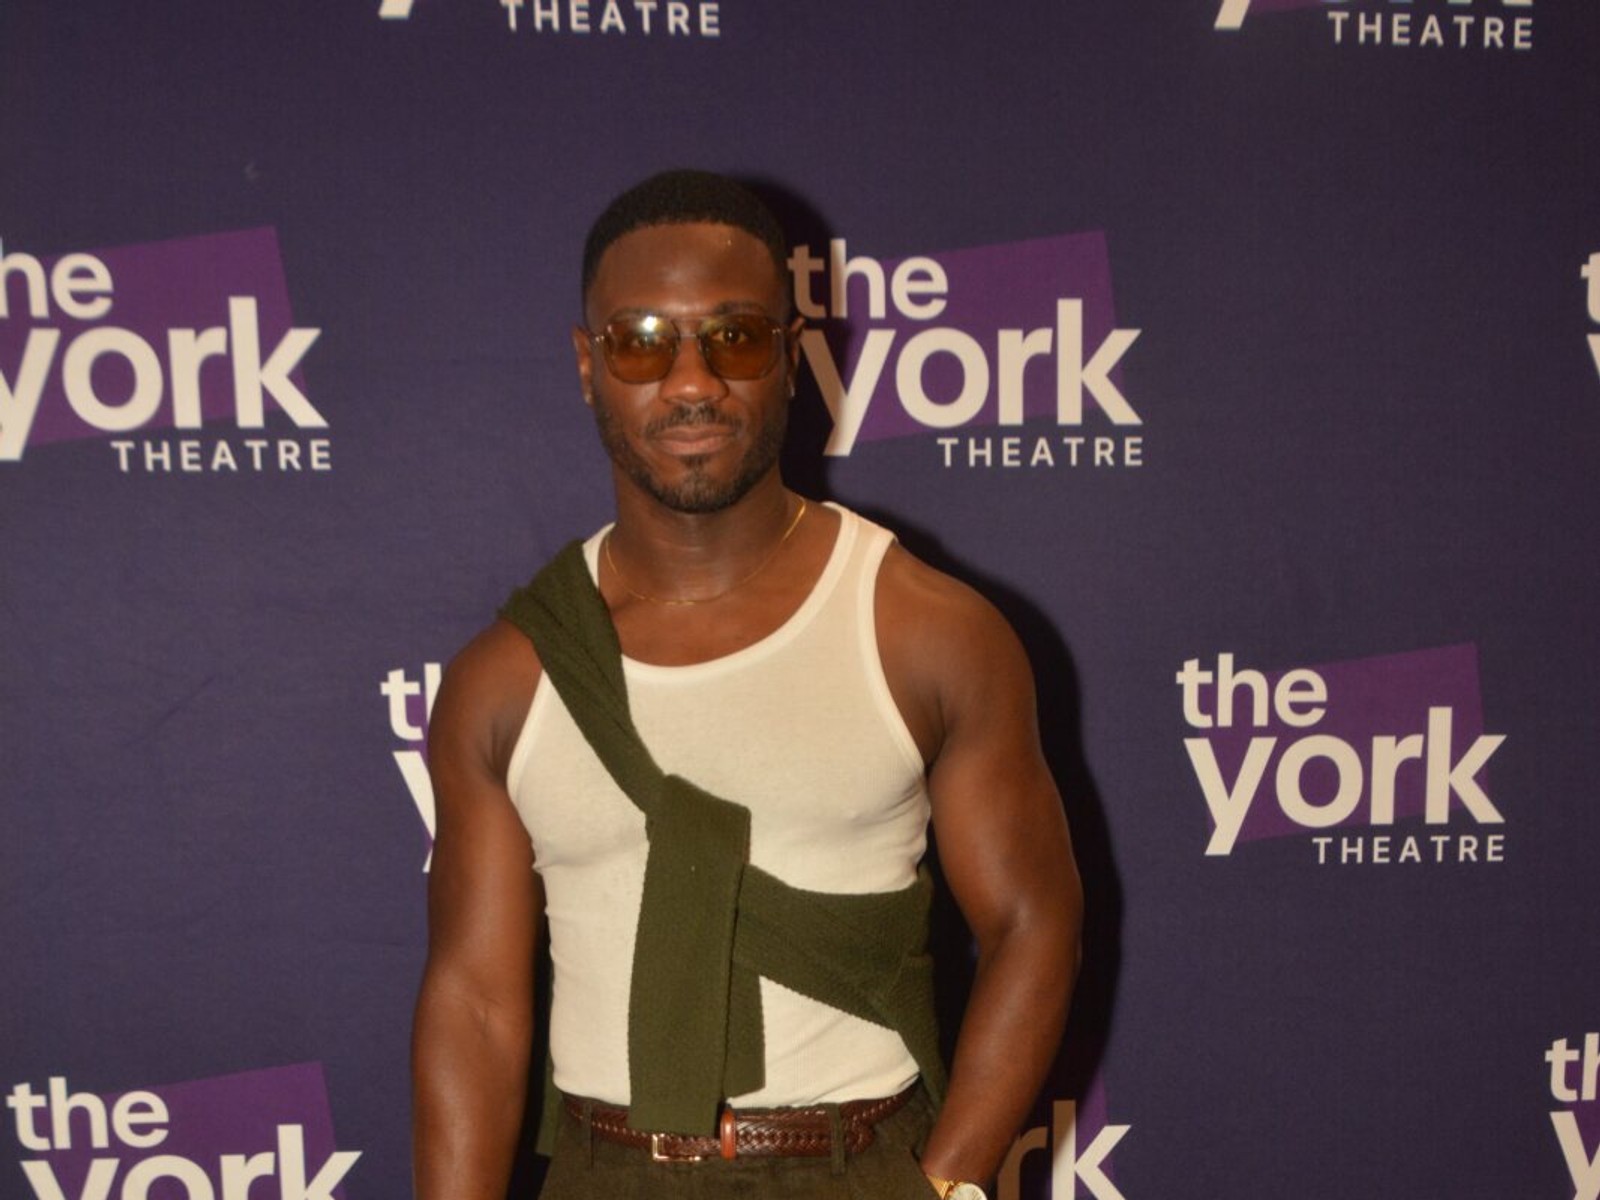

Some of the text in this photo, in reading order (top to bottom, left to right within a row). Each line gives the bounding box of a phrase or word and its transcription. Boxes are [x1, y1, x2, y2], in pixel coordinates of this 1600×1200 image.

[503, 0, 721, 36] THEATRE
[1328, 11, 1533, 49] THEATRE
[0, 237, 114, 320] he
[787, 238, 948, 320] the
[800, 298, 1142, 457] york
[111, 439, 332, 472] THEATRE
[937, 437, 1144, 467] THEATRE
[1175, 652, 1328, 727] the
[1183, 706, 1507, 856] york
[1312, 834, 1505, 865] THEATRE
[5, 1076, 170, 1151] the
